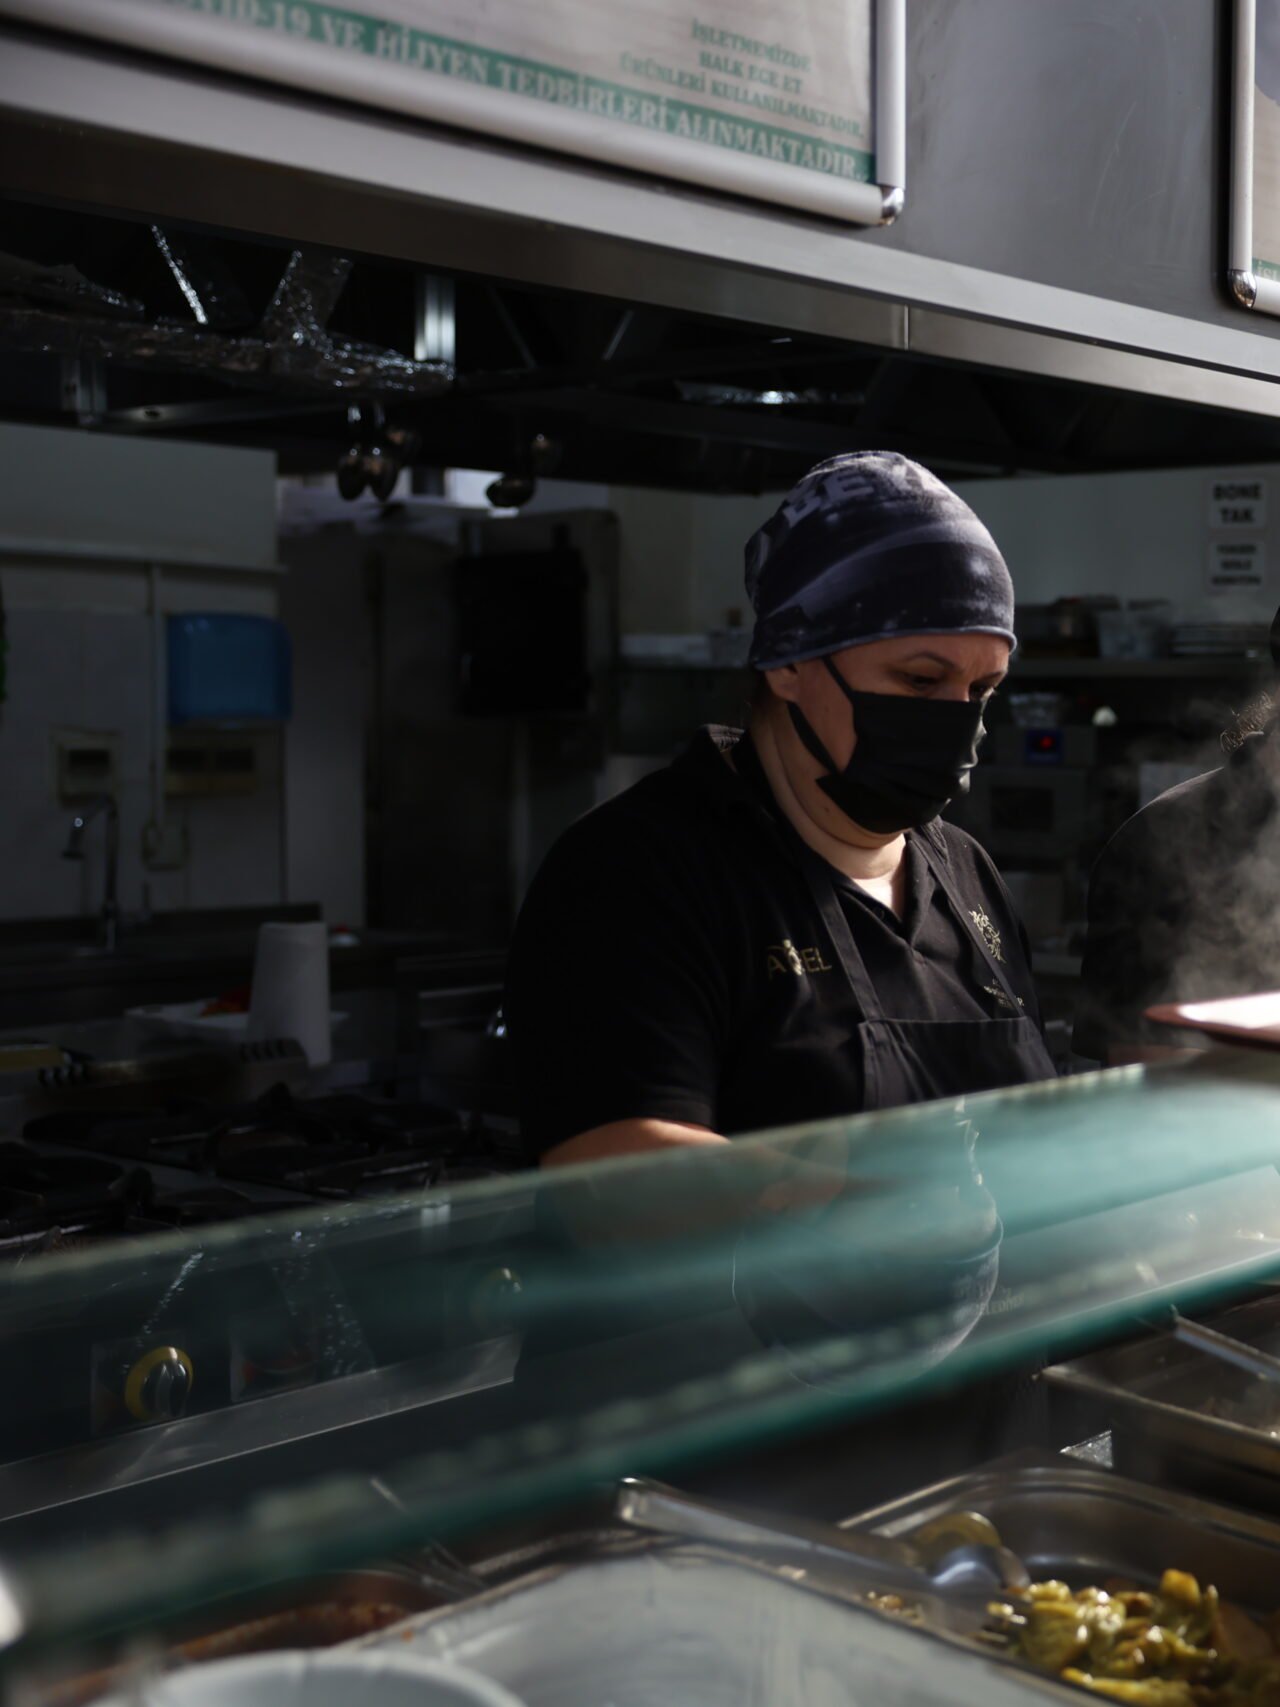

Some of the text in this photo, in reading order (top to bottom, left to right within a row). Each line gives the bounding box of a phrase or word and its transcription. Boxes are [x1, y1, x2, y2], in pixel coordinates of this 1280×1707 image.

[690, 17, 811, 78] İŞLETMEMİZDE
[321, 13, 366, 52] VE
[375, 26, 489, 88] HİJYEN
[496, 60, 668, 132] TEDBİRLERİ
[619, 50, 705, 94] ÜRÜNLERİ
[699, 50, 803, 95] HALK EGE ET
[1213, 482, 1262, 502] BONE
[1219, 506, 1255, 524] TAK
